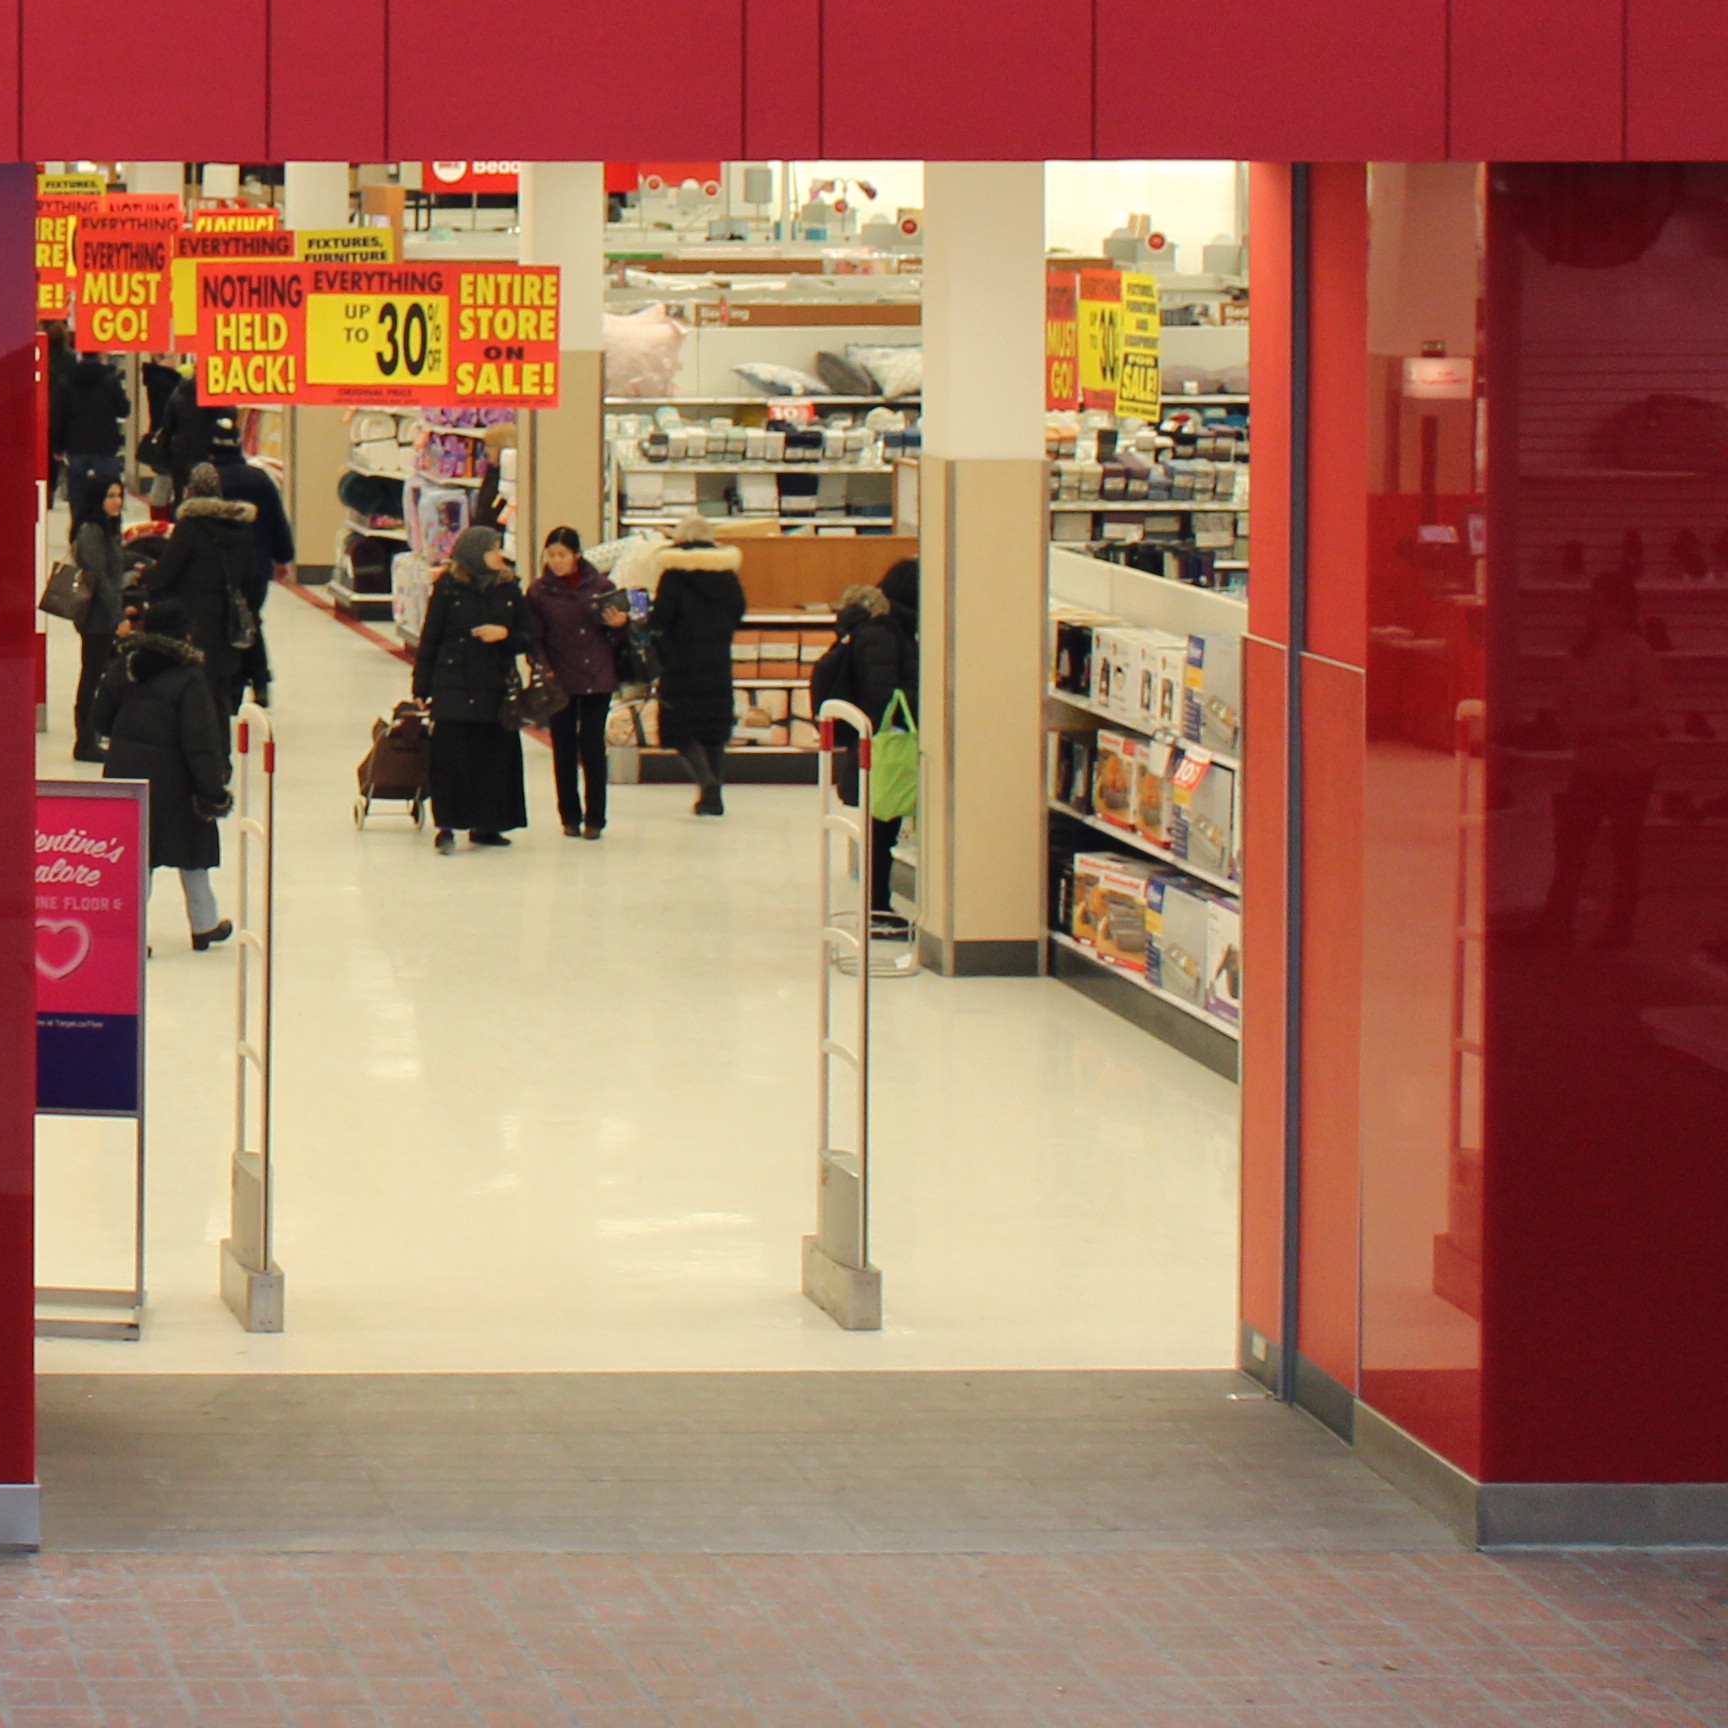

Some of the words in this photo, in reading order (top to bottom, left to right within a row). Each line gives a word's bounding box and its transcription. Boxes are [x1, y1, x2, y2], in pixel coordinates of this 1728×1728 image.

[84, 242, 164, 271] EVERYTHING
[180, 237, 289, 257] EVERYTHING
[308, 236, 383, 250] FIXTURES,
[82, 272, 161, 306] MUST
[203, 275, 302, 308] NOTHING
[314, 271, 443, 292] EVERYTHING
[459, 273, 557, 306] ENTIRE
[92, 307, 149, 342] GO!
[345, 304, 370, 319] UP
[459, 308, 556, 341] STORE
[216, 313, 288, 351] HELD
[345, 328, 369, 343] TO
[484, 347, 524, 360] ON
[207, 355, 296, 395] BACK!
[456, 362, 555, 395] SALE!
[1122, 366, 1157, 402] SALE!
[35, 829, 125, 863] entine's
